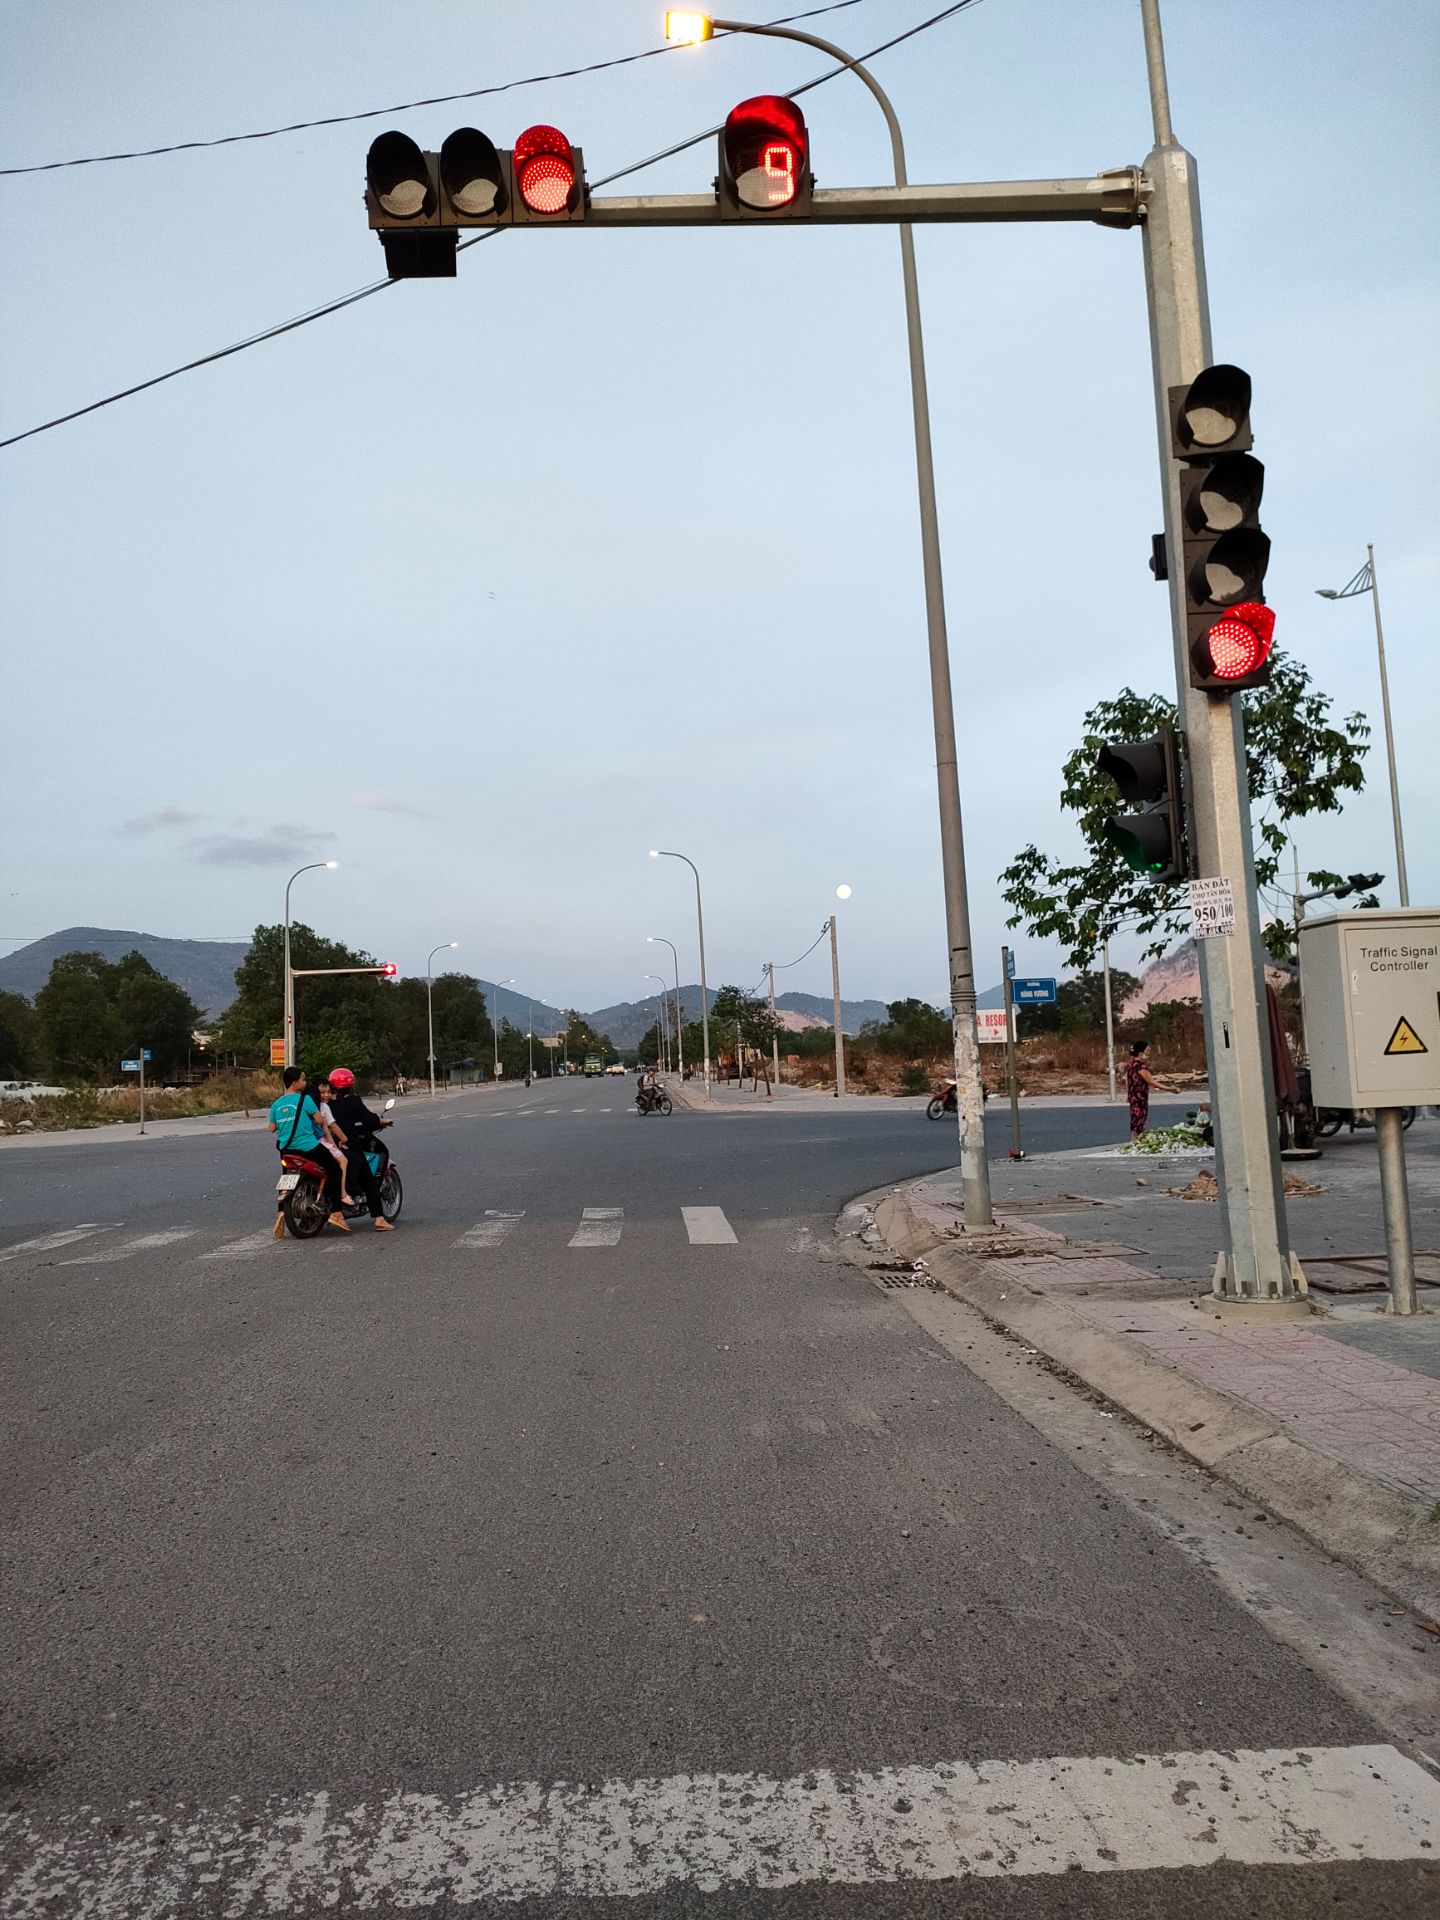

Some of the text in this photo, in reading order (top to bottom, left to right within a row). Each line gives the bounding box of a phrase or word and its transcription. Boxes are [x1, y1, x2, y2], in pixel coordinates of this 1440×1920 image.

[765, 147, 794, 200] 9
[1194, 903, 1234, 923] 950/100
[1360, 945, 1438, 958] Traffic Signal
[1370, 960, 1429, 972] Controller
[985, 1014, 1007, 1027] RESOR
